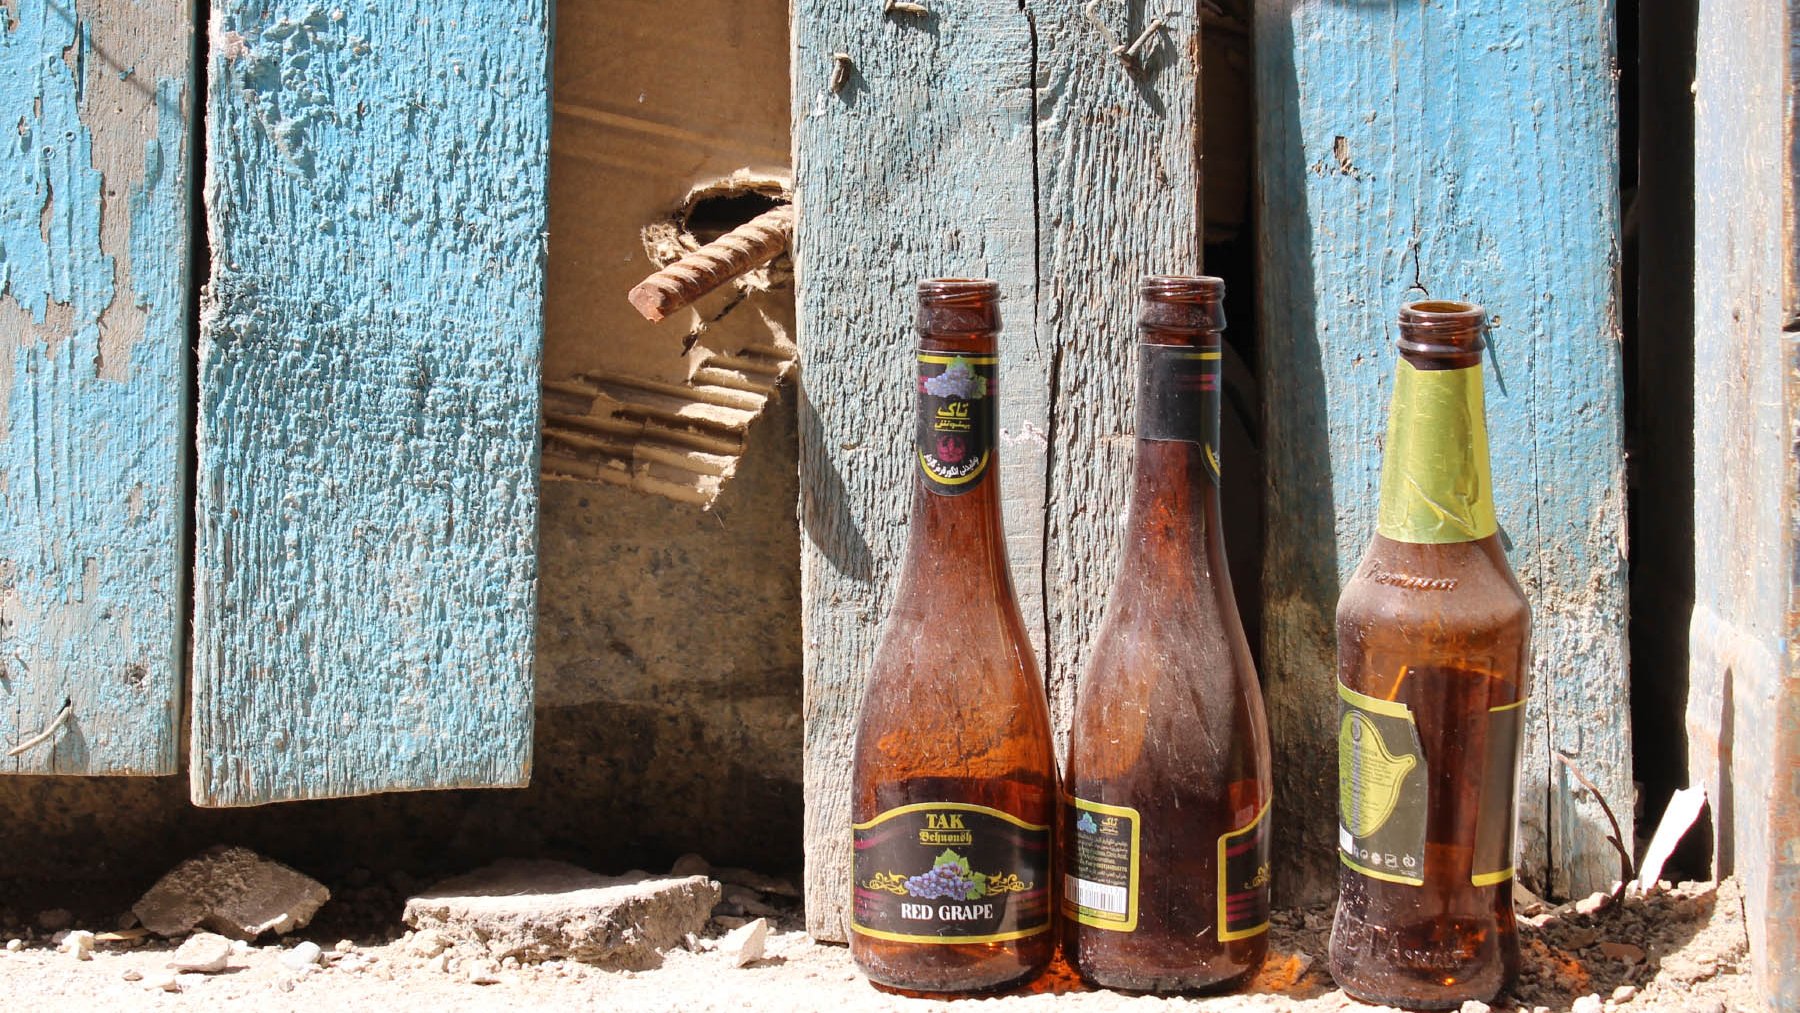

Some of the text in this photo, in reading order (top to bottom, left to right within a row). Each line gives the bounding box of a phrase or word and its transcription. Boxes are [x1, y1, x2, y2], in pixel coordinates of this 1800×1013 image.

[937, 402, 969, 417] تاک
[926, 813, 965, 829] TAK
[901, 903, 994, 920] RED GRAPE
